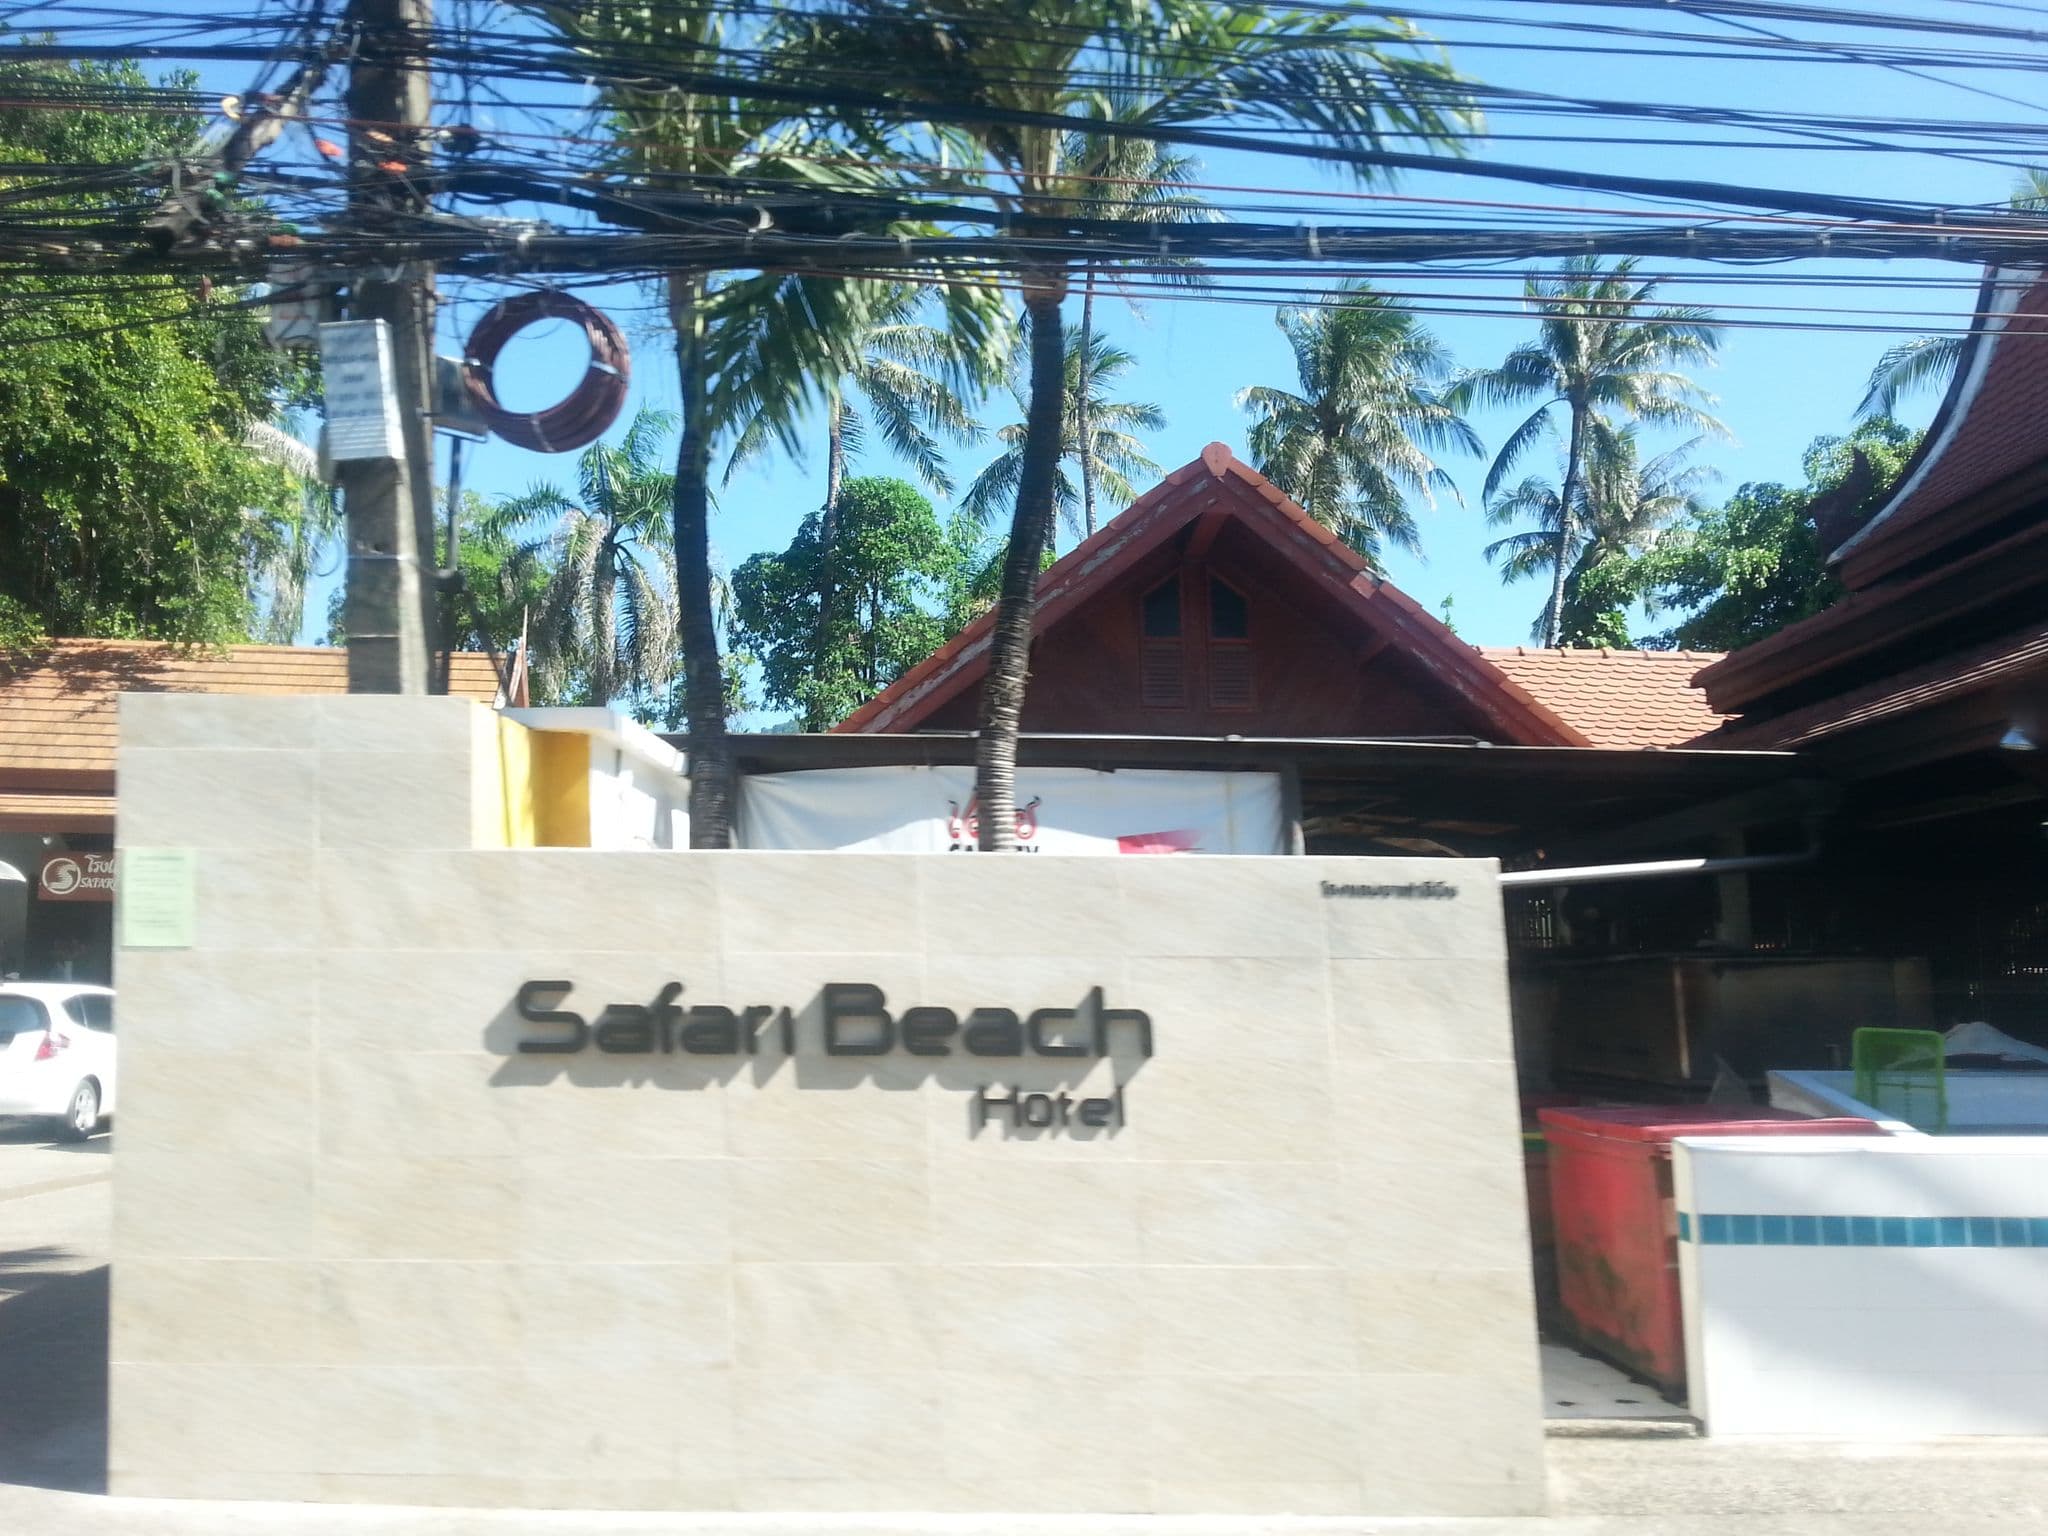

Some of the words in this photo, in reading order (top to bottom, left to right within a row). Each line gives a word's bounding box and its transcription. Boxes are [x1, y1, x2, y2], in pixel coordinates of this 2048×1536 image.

[517, 979, 795, 1056] Safari
[823, 983, 1154, 1057] Beach
[976, 1085, 1124, 1128] Hotel
